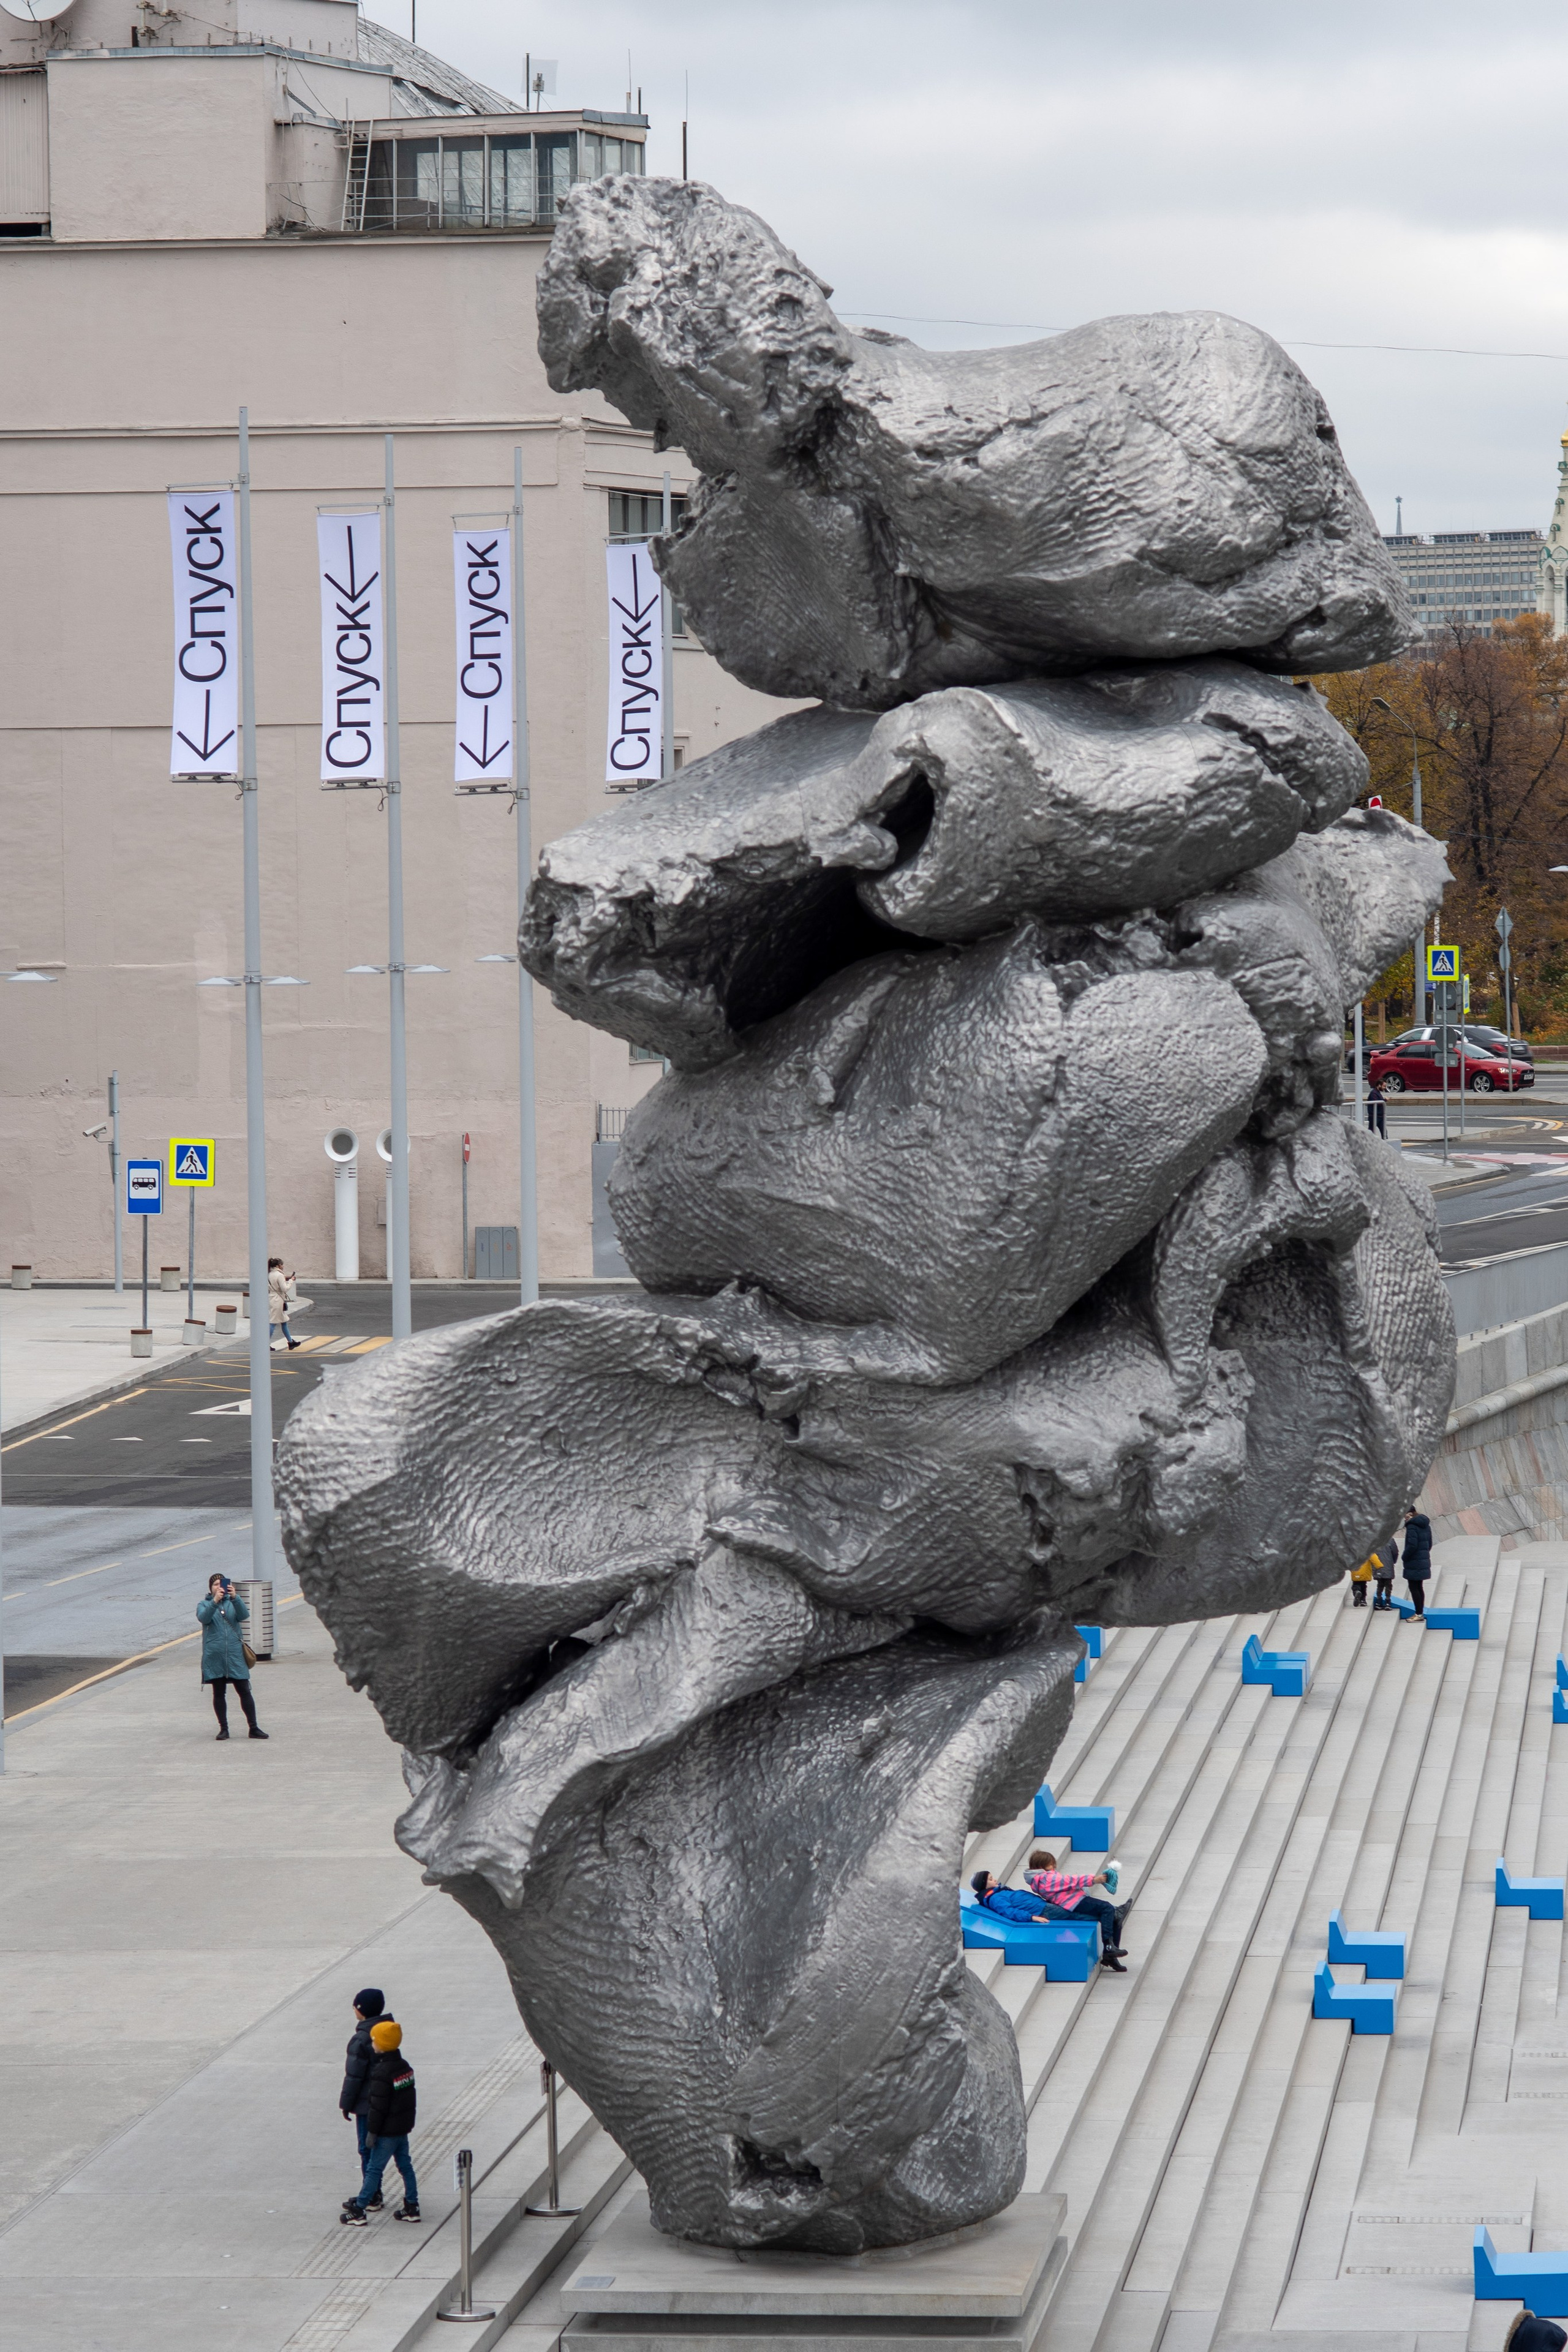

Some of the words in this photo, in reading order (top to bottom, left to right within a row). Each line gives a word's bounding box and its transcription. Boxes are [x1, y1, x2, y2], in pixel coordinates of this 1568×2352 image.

[178, 502, 234, 682] Спуск
[460, 539, 509, 699] Спуск
[325, 600, 380, 768] Спуск
[609, 620, 659, 771] Спуск
